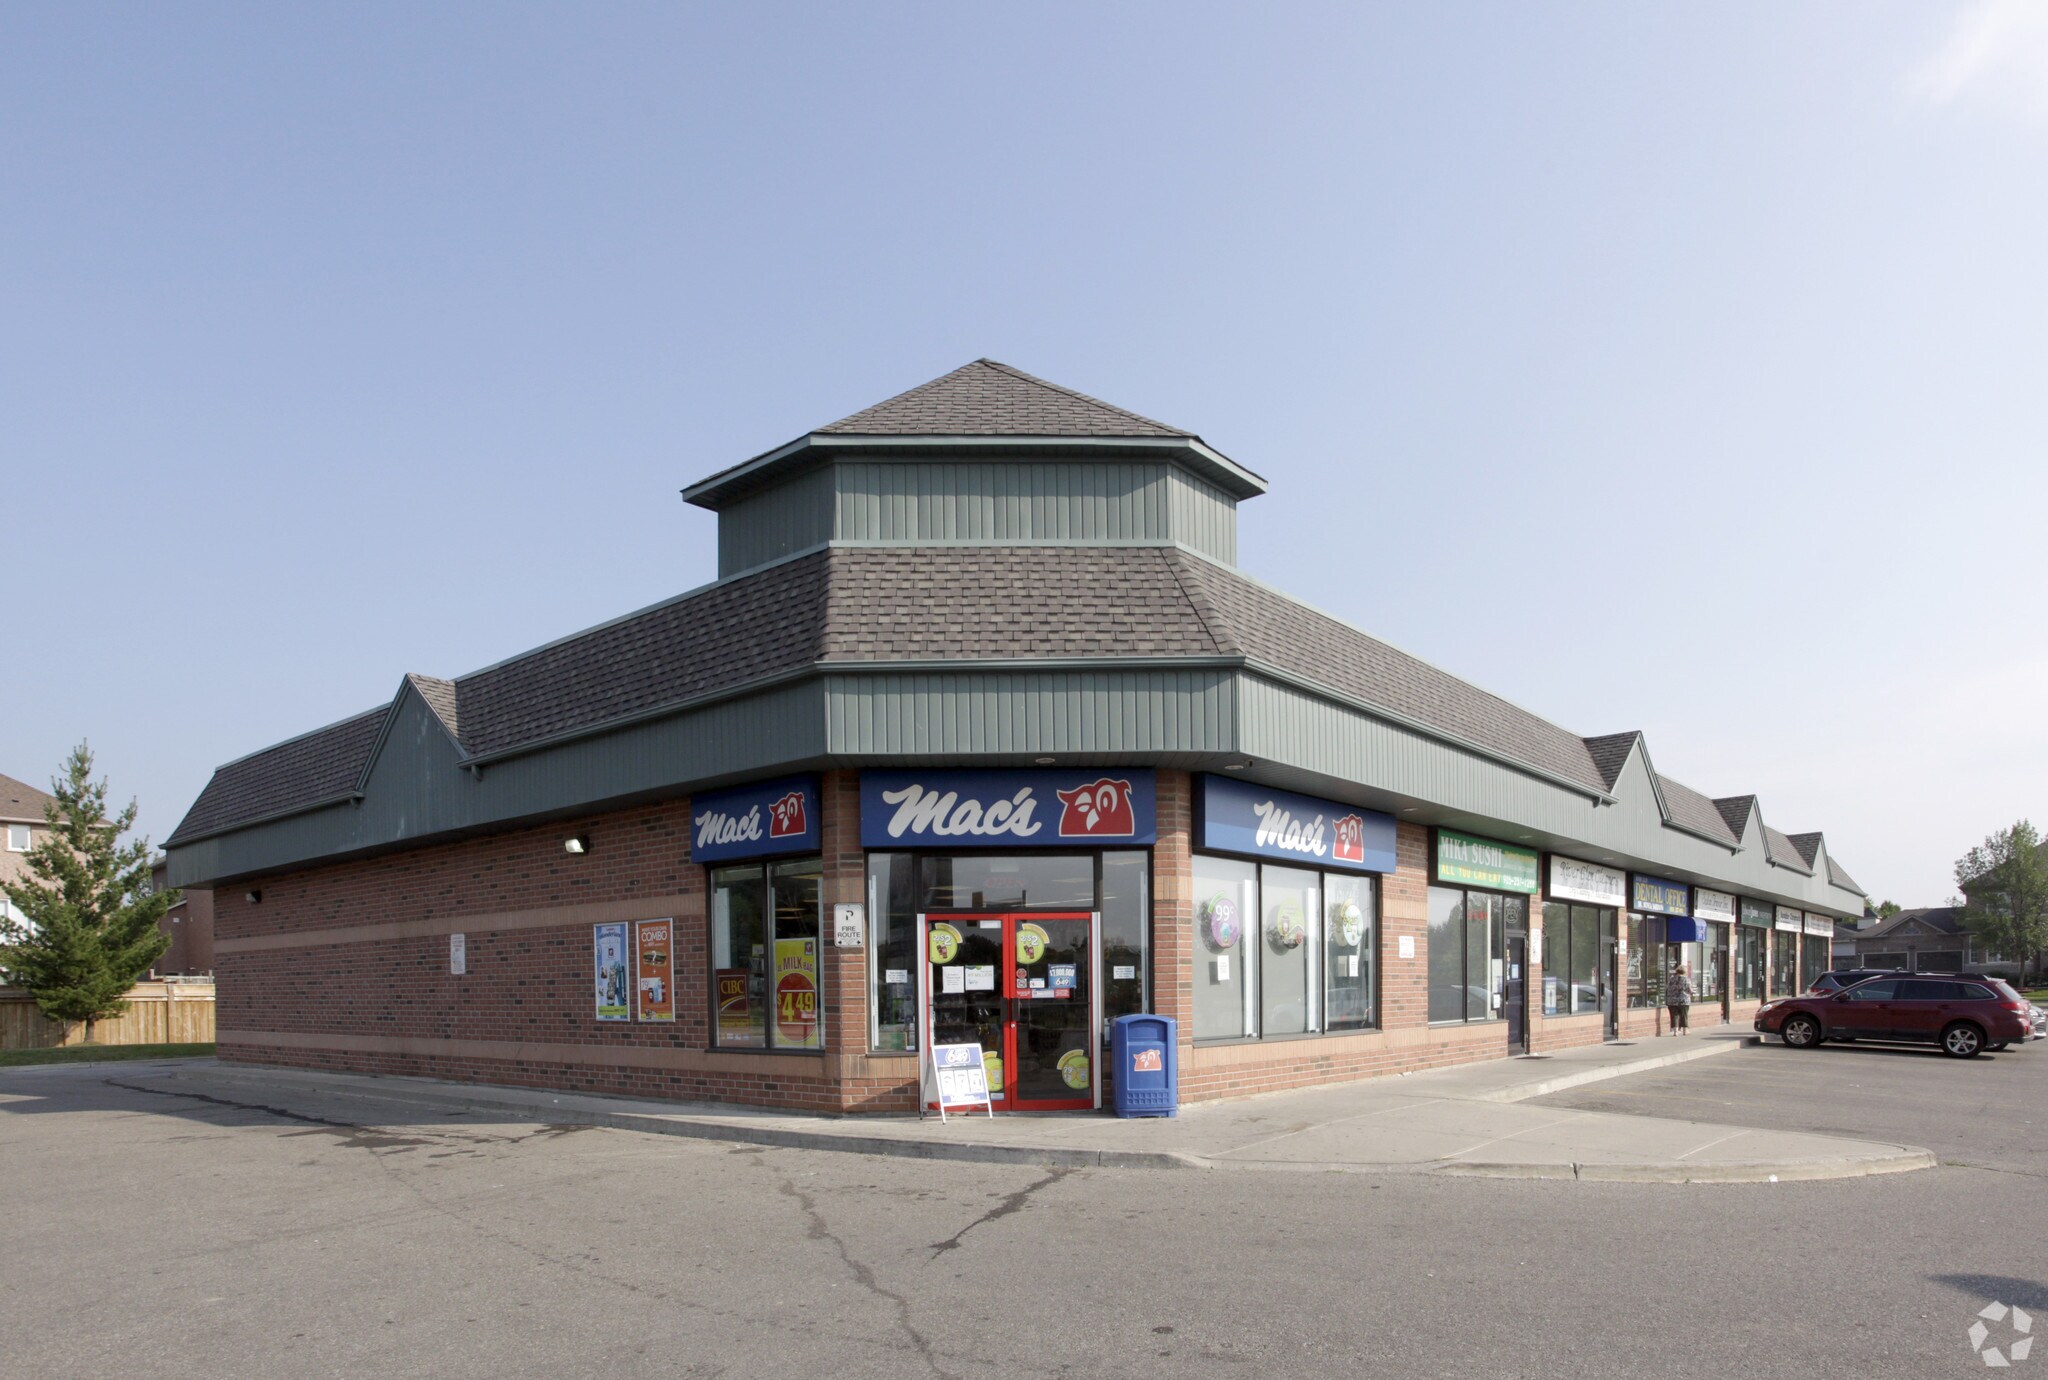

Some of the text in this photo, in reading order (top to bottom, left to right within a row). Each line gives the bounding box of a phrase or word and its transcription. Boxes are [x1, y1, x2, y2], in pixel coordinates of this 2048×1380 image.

[882, 783, 1042, 838] Mac's
[695, 804, 763, 849] Mac's
[1253, 800, 1328, 857] Mac's
[1440, 835, 1468, 862] MIKA
[1472, 843, 1502, 868] SUSHI
[1441, 863, 1501, 883] ALL YOU CAN EAT
[1635, 882, 1664, 904] DENTAL
[1665, 887, 1686, 908] OFFICE
[641, 930, 668, 942] COMBO
[783, 956, 803, 970] MILK
[720, 979, 744, 994] CIBC
